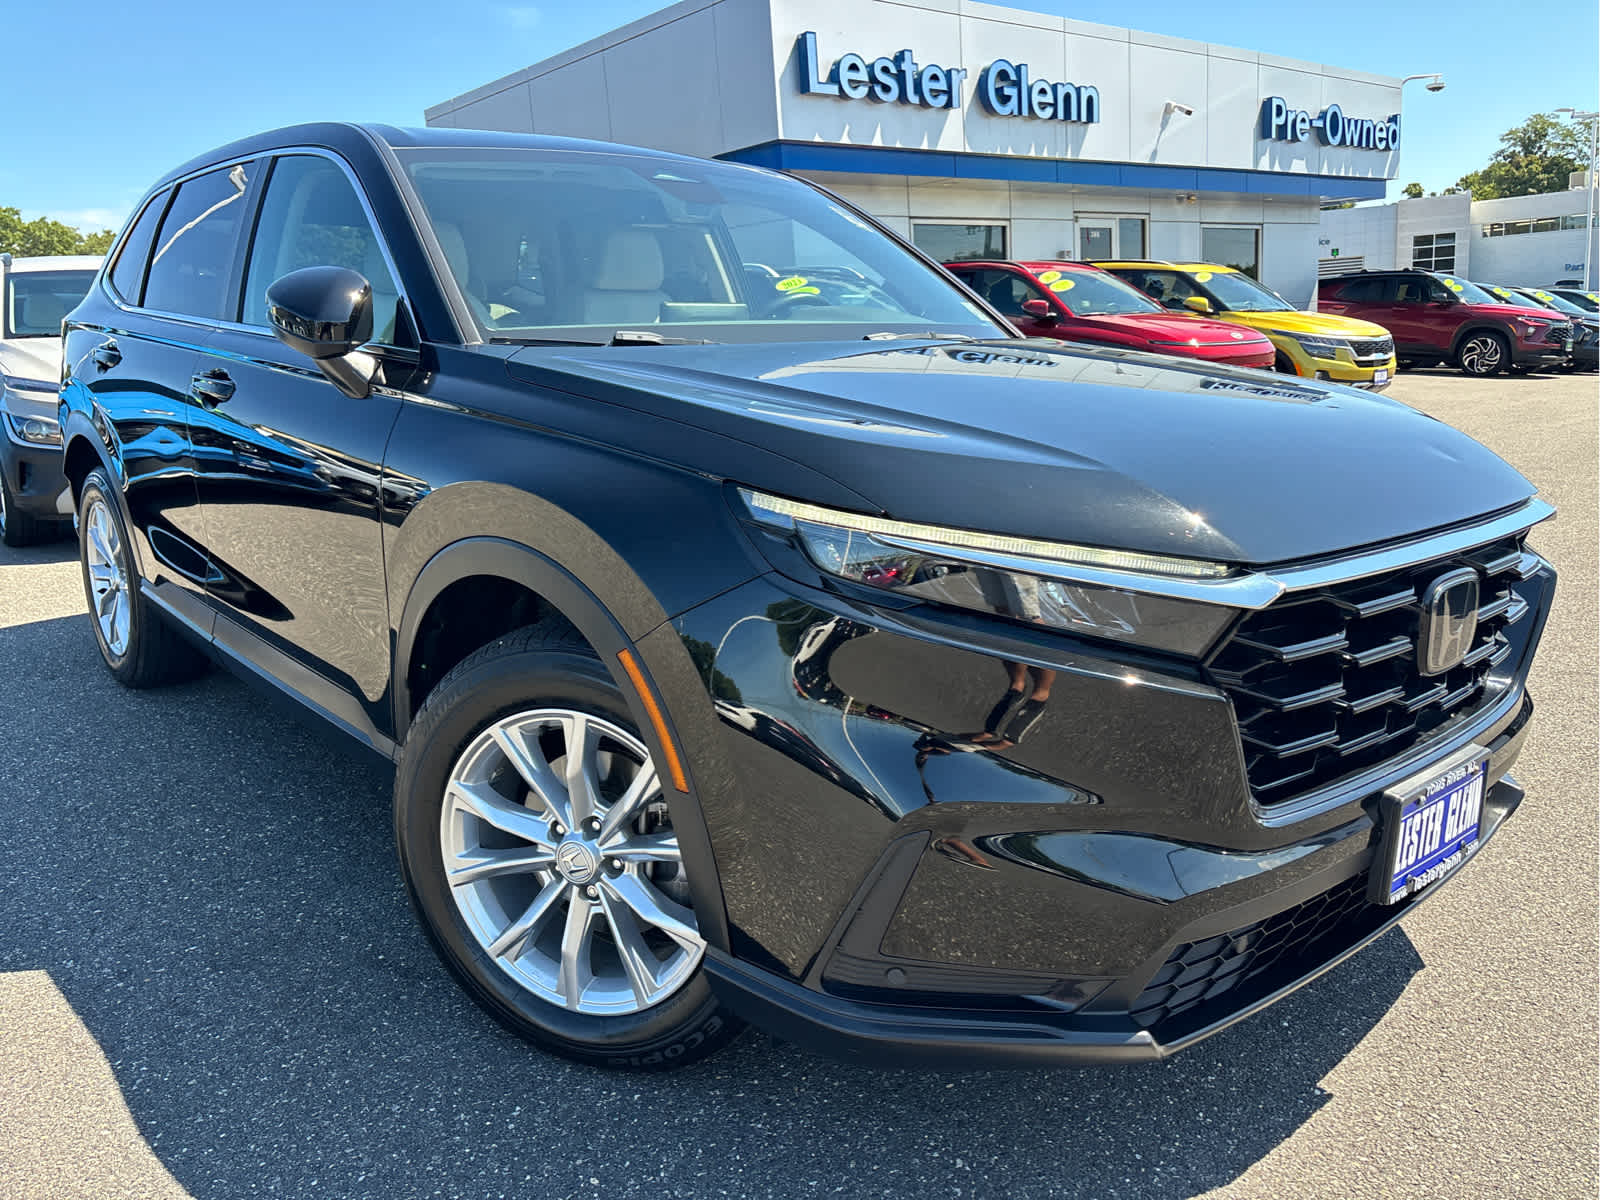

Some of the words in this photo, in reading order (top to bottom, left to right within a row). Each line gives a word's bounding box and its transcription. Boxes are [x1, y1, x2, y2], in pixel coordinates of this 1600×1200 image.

[800, 31, 967, 109] Lester
[978, 59, 1100, 123] Glenn
[1262, 96, 1401, 151] Pre-Owned
[1393, 799, 1445, 875] LESTER
[1446, 775, 1484, 844] GLENN
